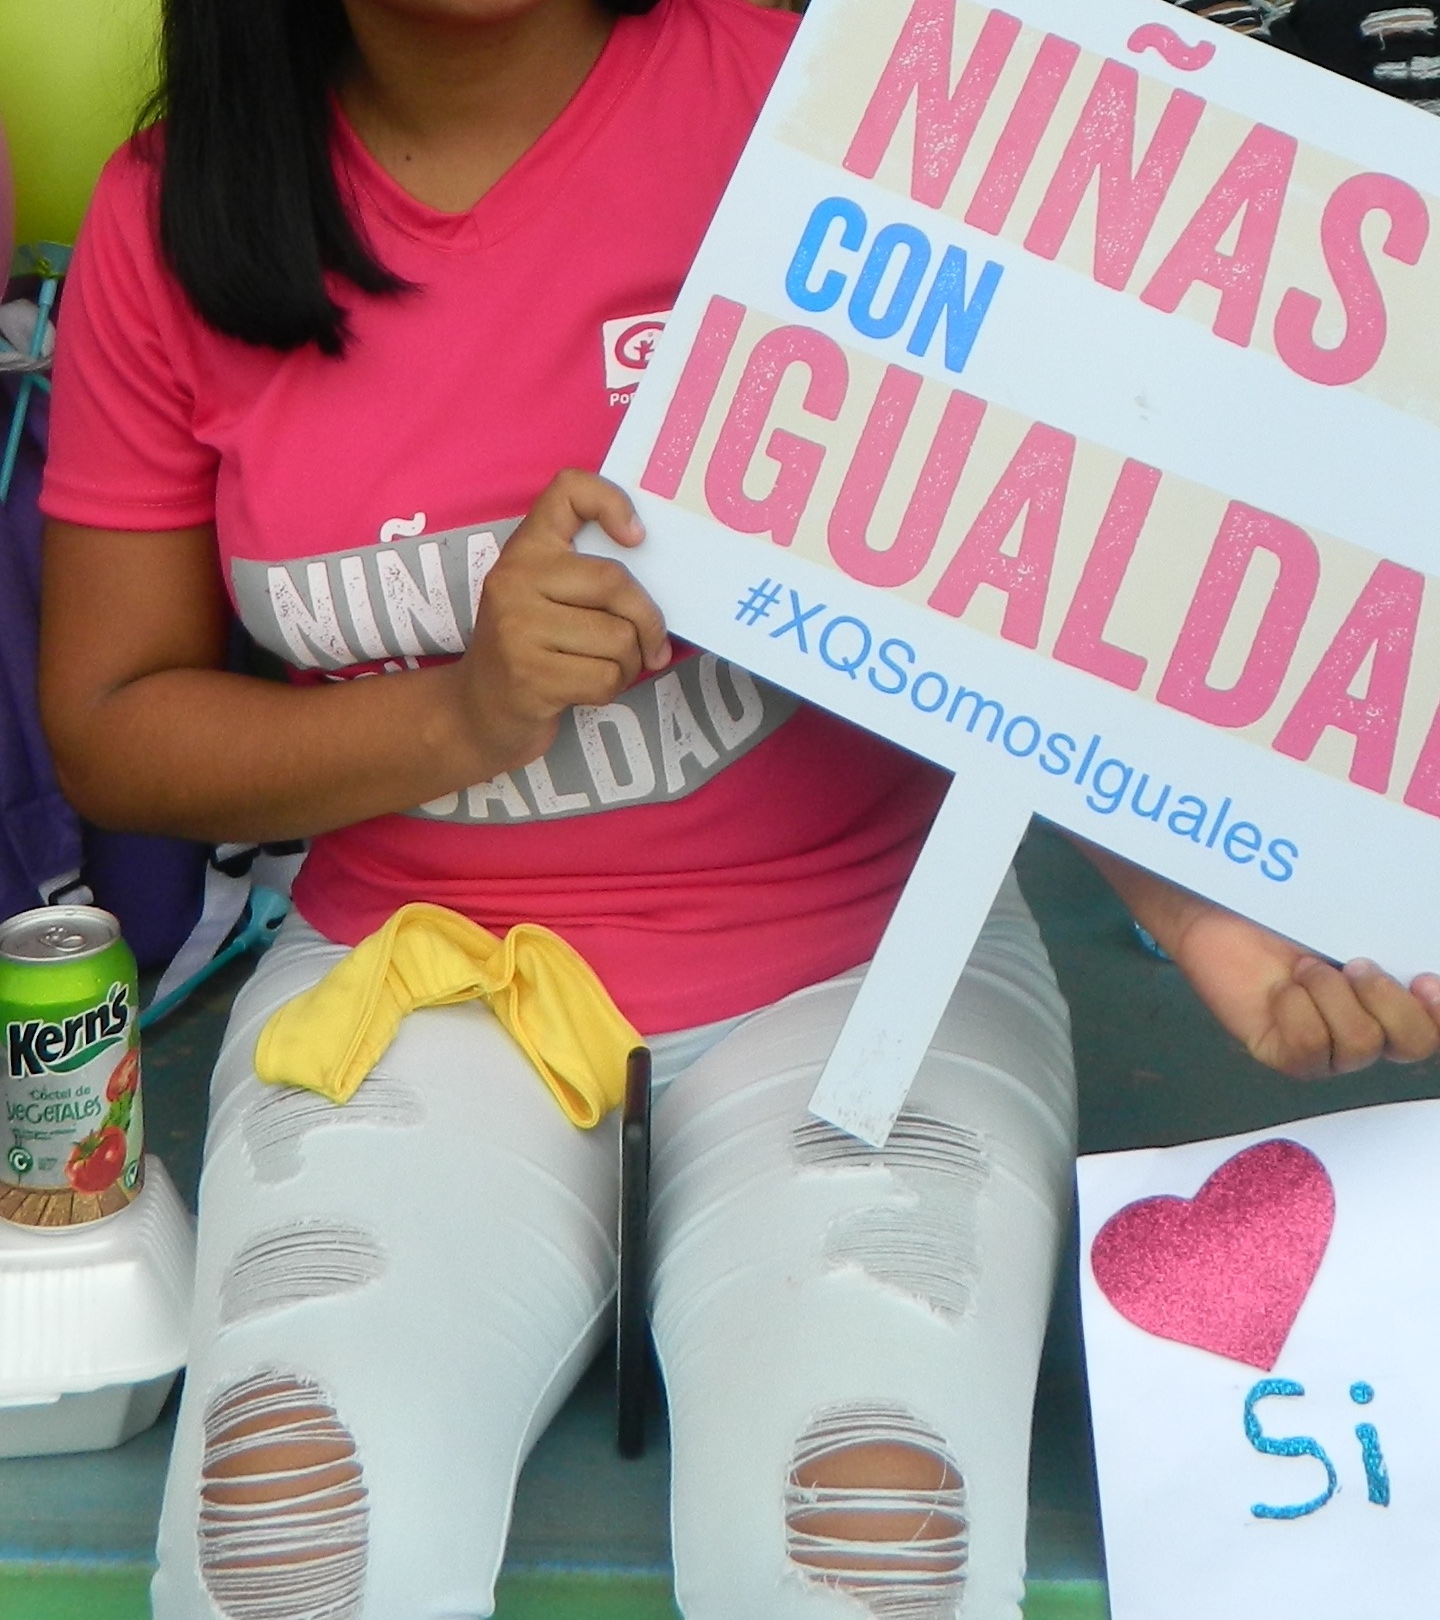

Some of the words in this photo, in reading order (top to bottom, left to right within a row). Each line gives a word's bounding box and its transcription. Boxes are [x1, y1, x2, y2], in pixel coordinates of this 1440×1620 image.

[785, 196, 1005, 374] CON
[735, 578, 1300, 883] #XQSomosIguales
[7, 981, 130, 1078] Kern's
[75, 1085, 91, 1097] de
[1243, 1377, 1391, 1520] Si
